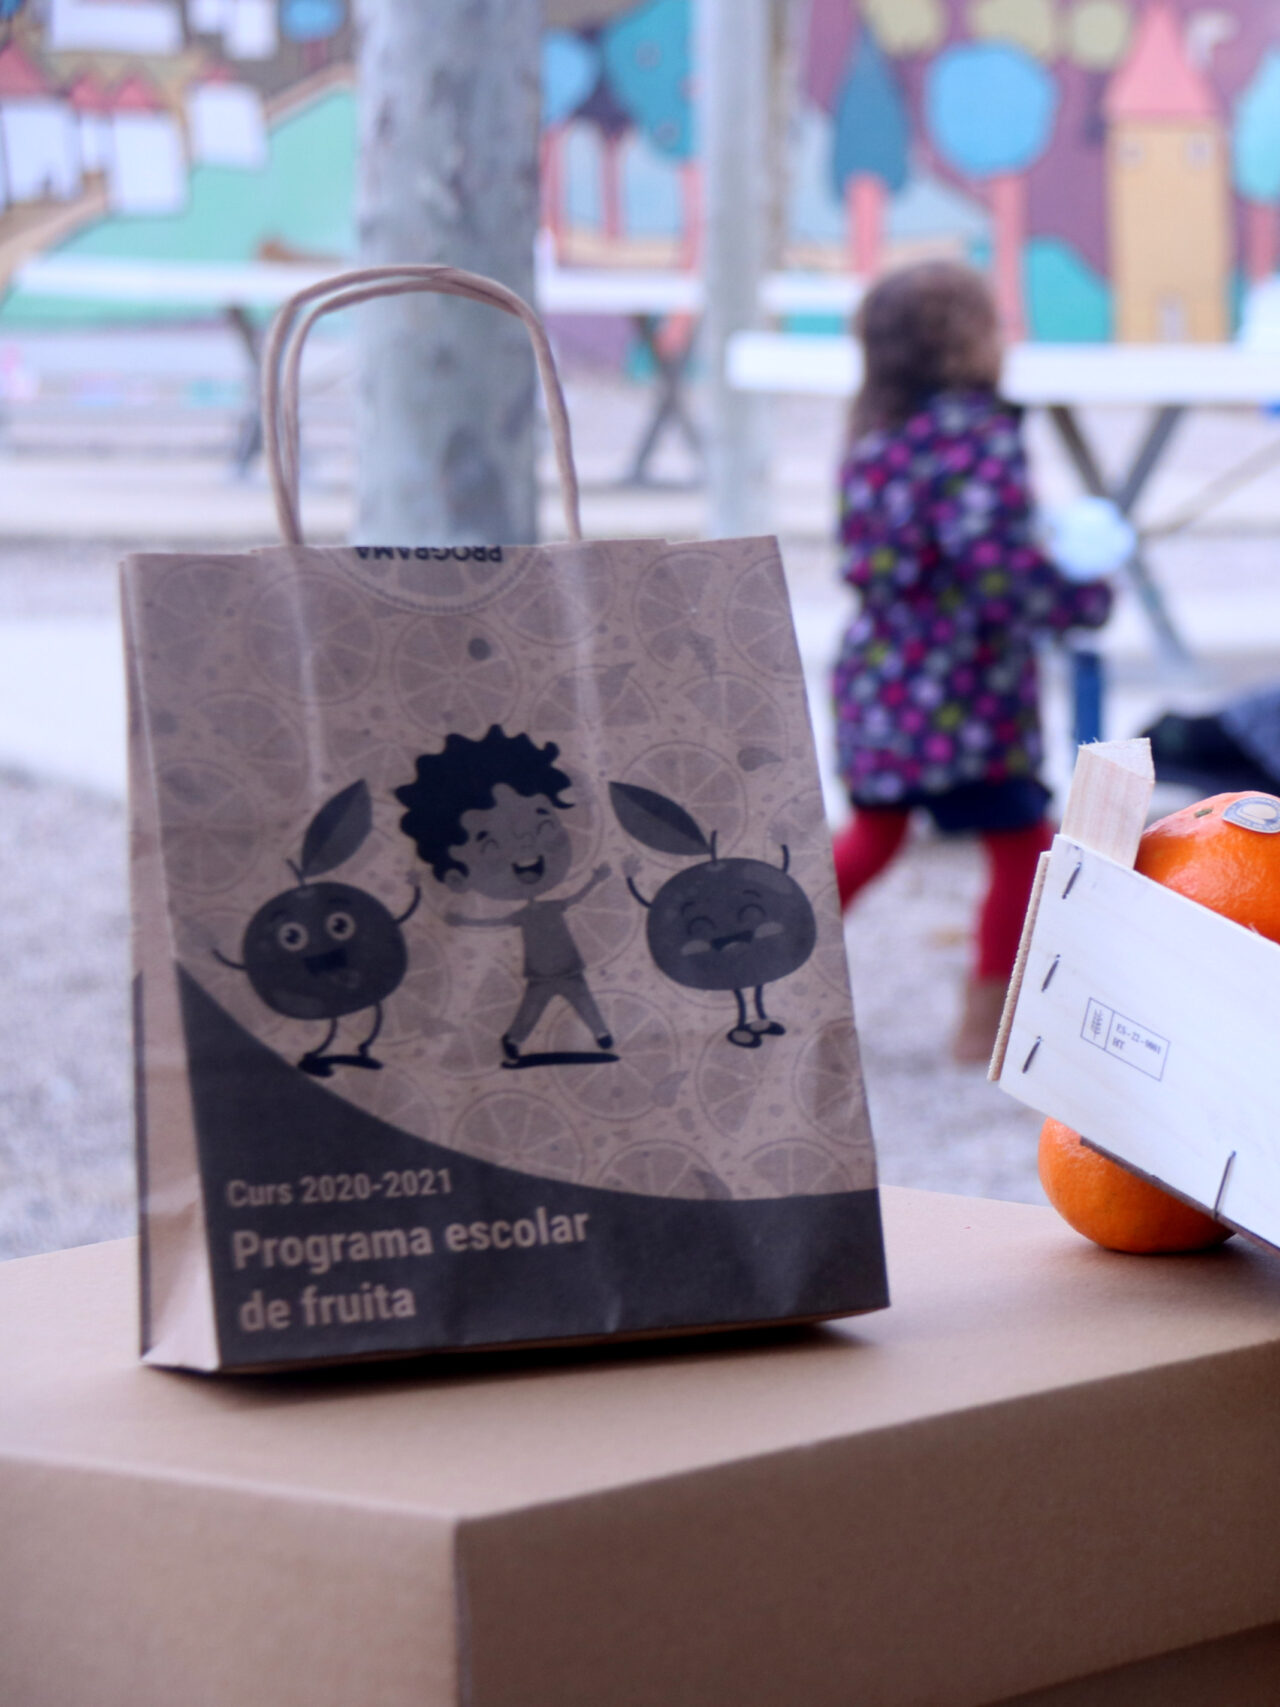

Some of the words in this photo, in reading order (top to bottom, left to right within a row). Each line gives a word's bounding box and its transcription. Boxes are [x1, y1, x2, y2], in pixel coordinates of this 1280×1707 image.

[226, 1179, 294, 1207] Curs
[301, 1168, 453, 1203] 2020-2021
[232, 1225, 434, 1274] Programa
[445, 1207, 590, 1253] escolar
[239, 1290, 292, 1332] de
[302, 1281, 417, 1328] fruita
